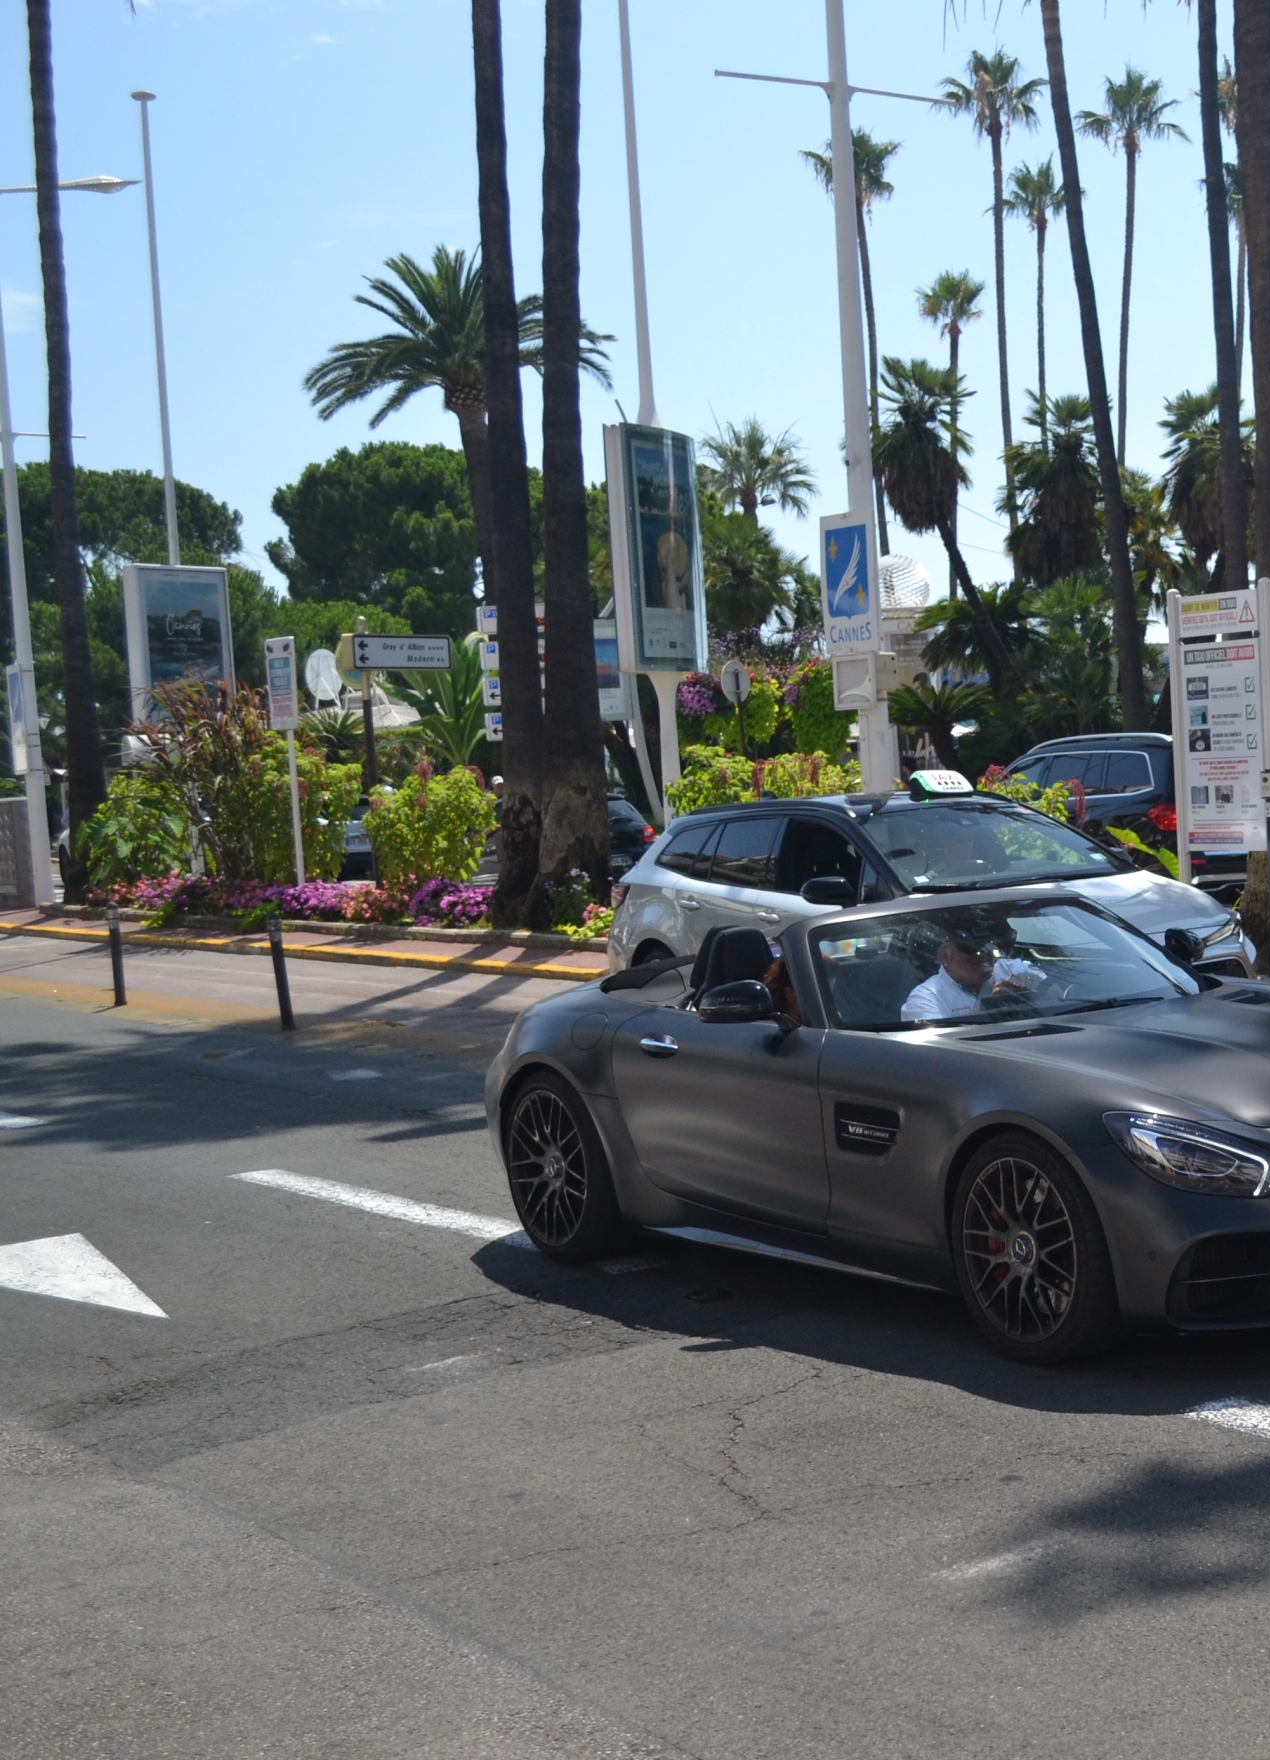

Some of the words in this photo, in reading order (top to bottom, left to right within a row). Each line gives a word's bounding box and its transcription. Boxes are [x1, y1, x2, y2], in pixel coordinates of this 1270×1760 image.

[407, 643, 425, 651] Albion
[1194, 651, 1205, 662] TAXI
[1205, 649, 1226, 661] OFFICIEL
[848, 1125, 863, 1134] V8
